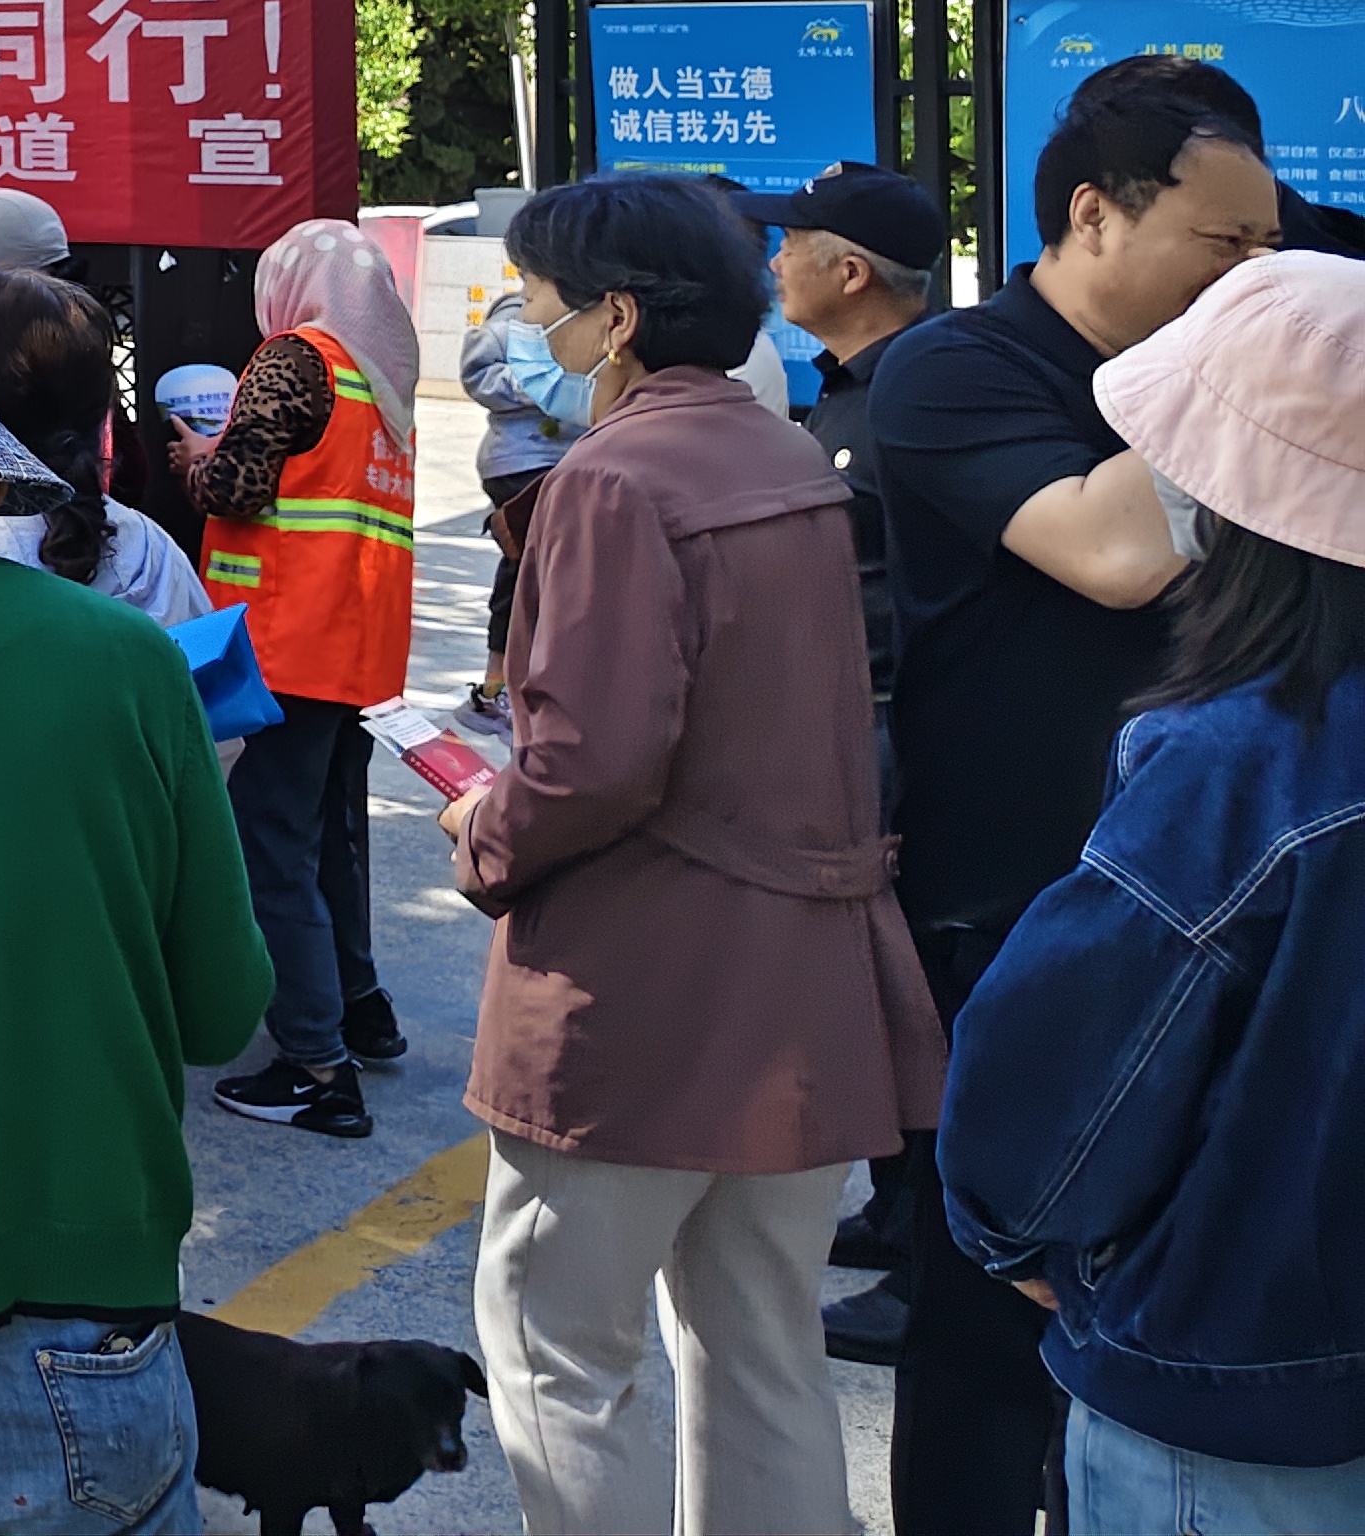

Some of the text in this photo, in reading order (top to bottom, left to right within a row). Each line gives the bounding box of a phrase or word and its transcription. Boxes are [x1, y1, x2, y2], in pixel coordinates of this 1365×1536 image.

[608, 66, 774, 101] 做人当立德
[610, 109, 777, 144] 诚信我为先
[187, 111, 284, 186] 宣
